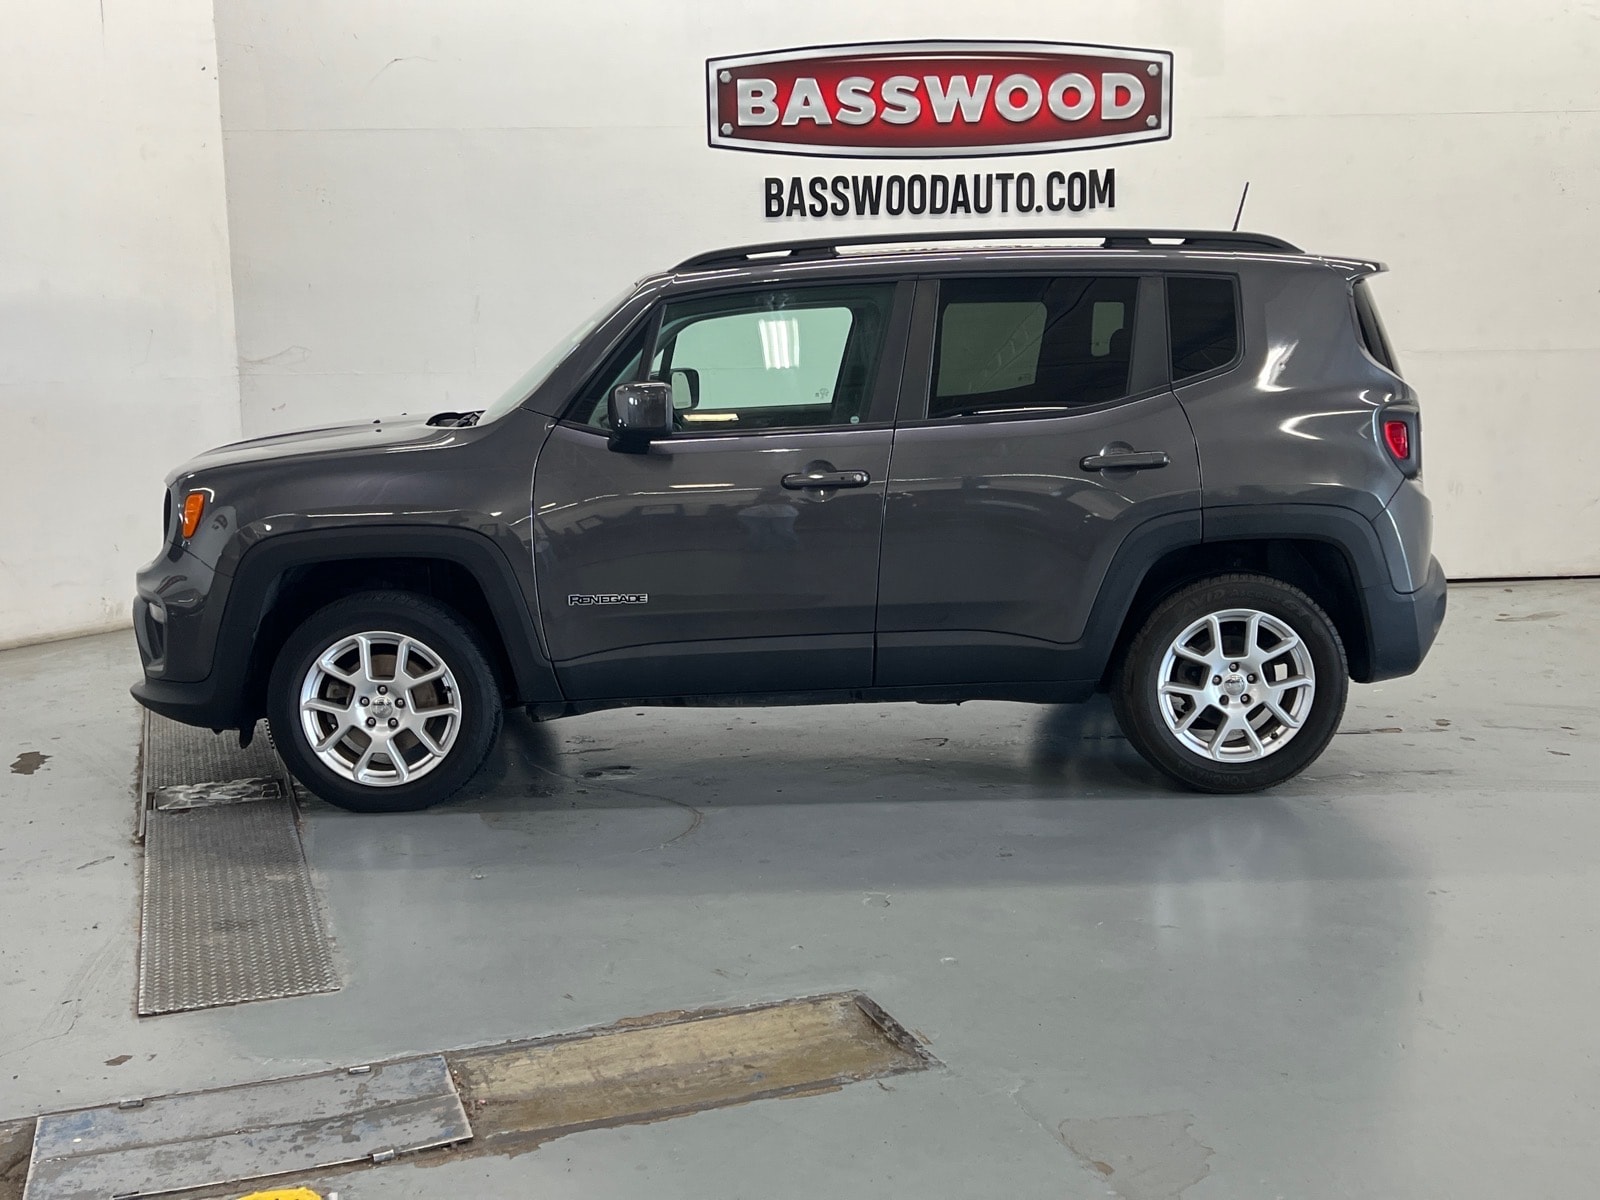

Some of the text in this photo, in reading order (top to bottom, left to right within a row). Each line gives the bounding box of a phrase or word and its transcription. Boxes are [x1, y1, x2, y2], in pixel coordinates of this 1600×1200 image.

[736, 73, 1145, 126] BASSWOOD
[764, 168, 1116, 217] BASSWOODAUTO.COM
[568, 593, 648, 606] RENEGADE
